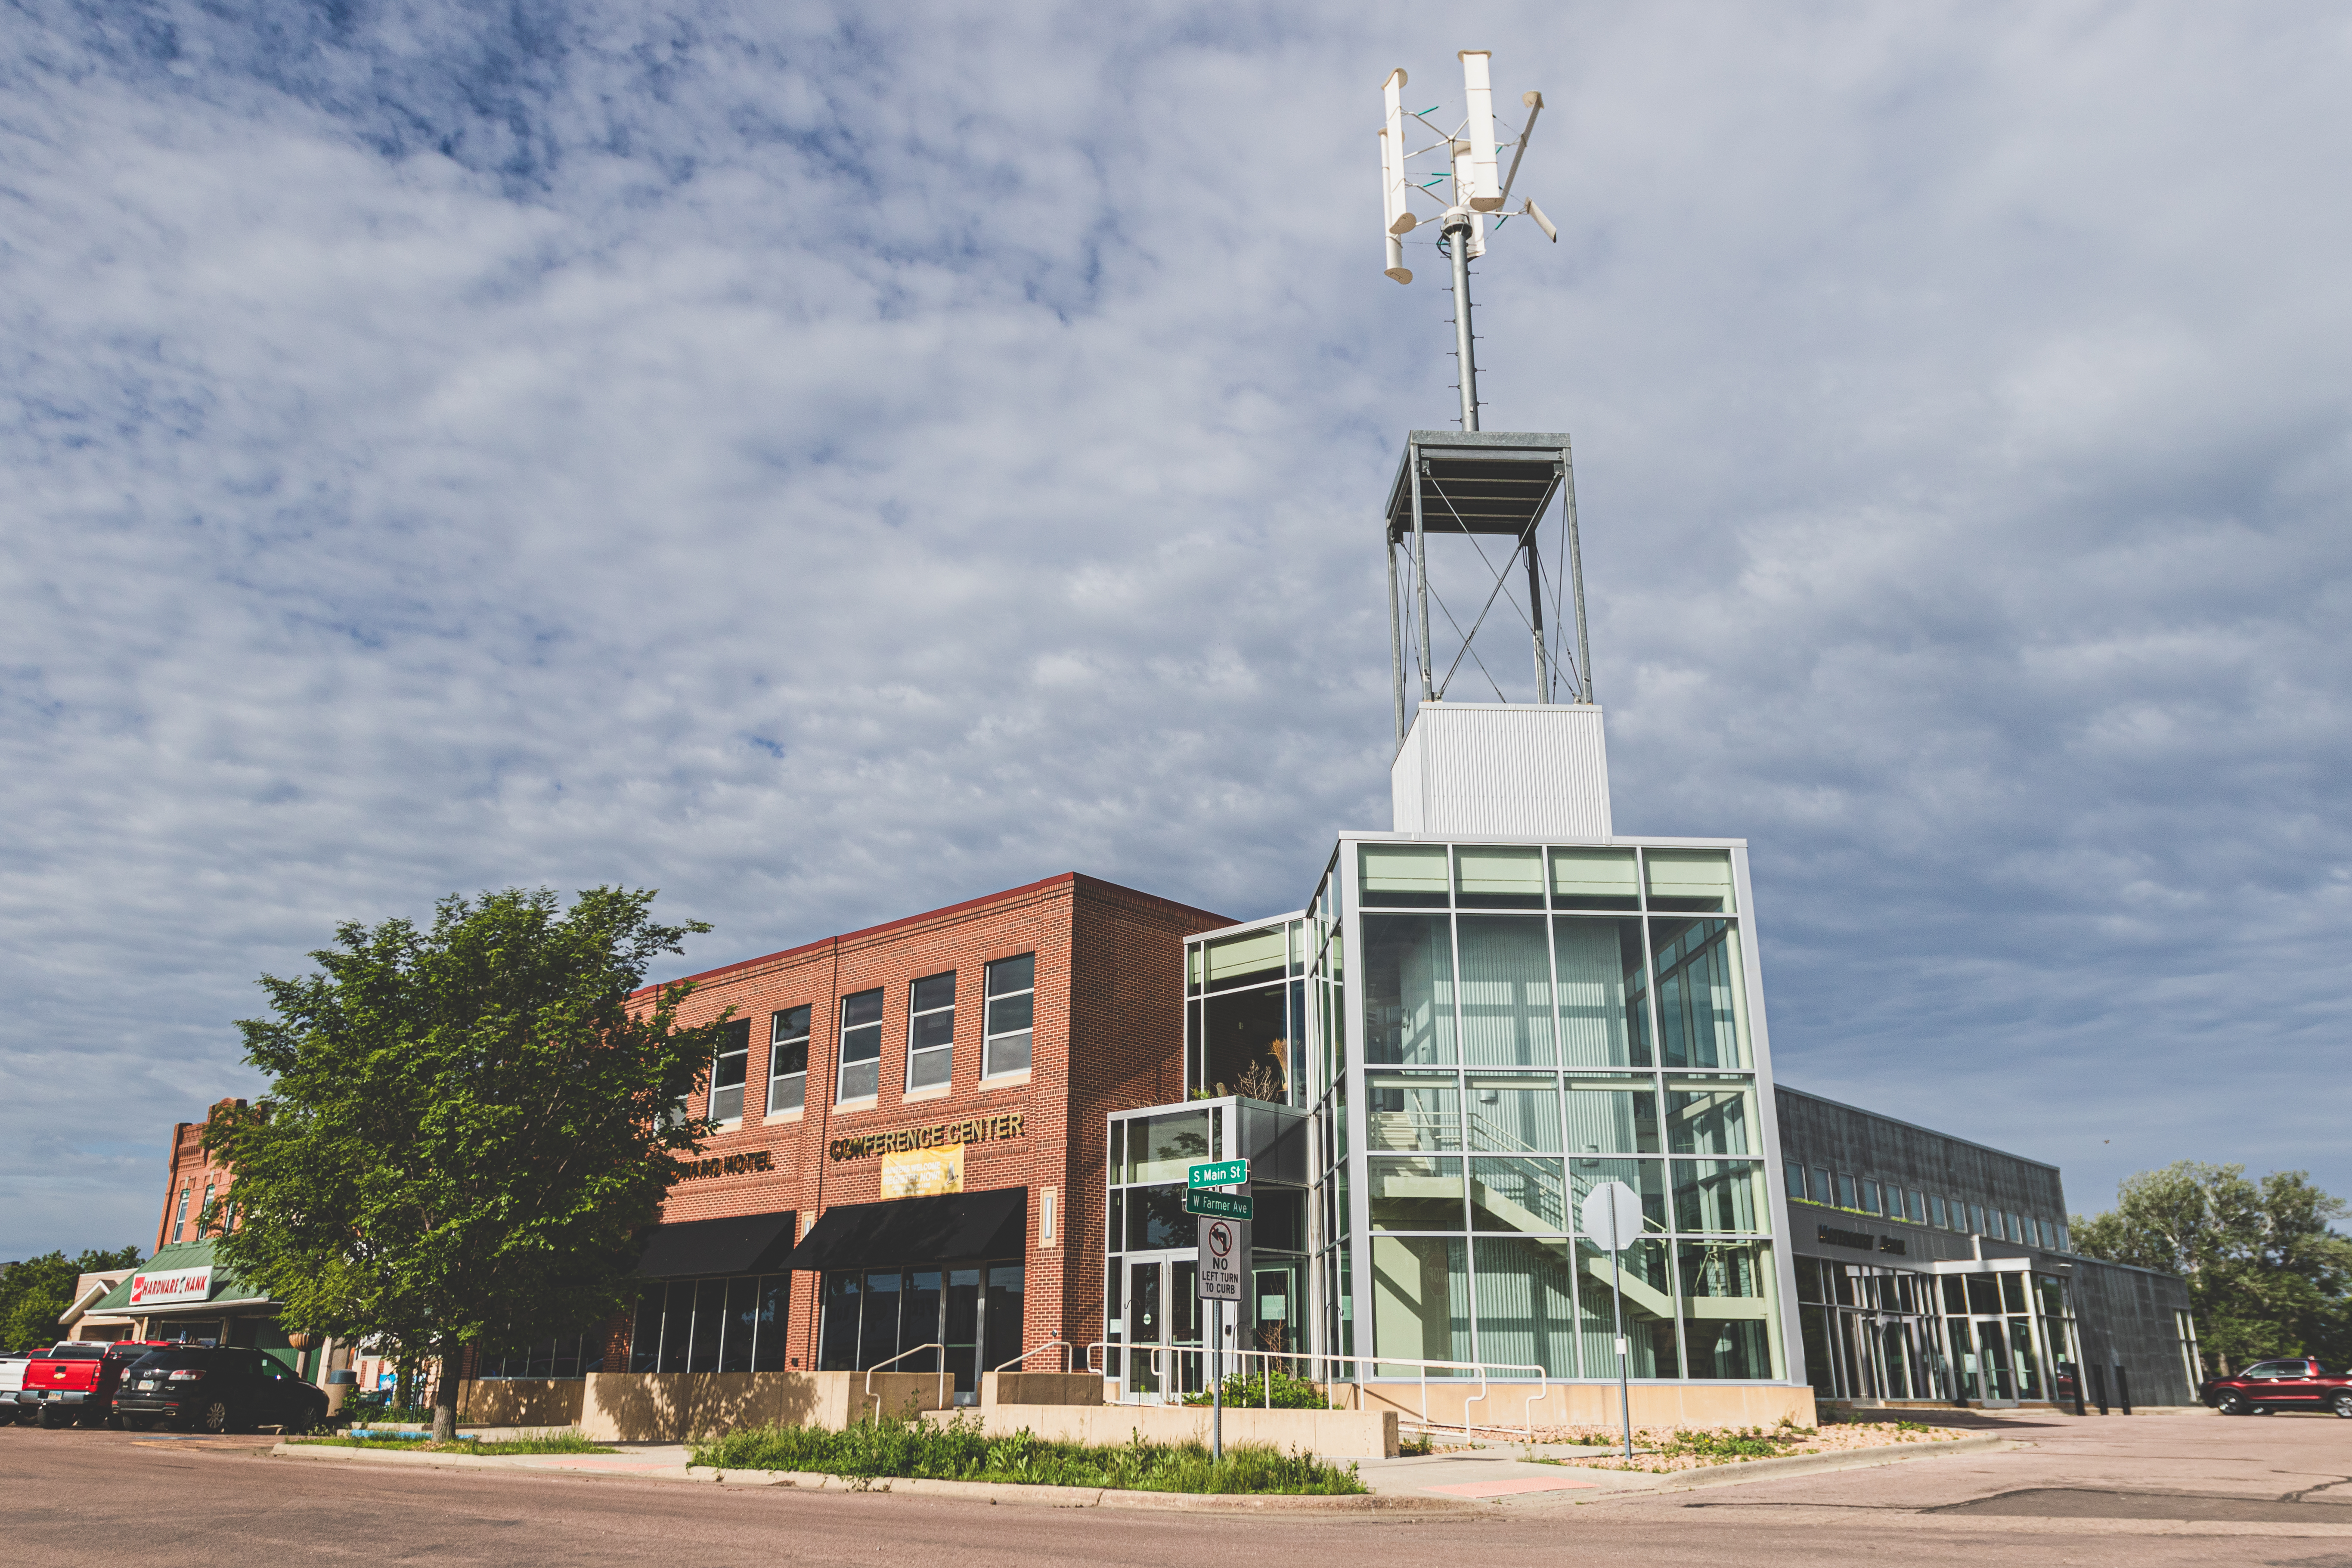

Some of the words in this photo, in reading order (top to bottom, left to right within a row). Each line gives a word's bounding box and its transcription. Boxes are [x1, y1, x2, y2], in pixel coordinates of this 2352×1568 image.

[830, 1125, 944, 1161] CONFERENCE
[947, 1113, 1024, 1143] CENTER
[724, 1150, 775, 1176] HOTEL
[883, 1164, 910, 1175] HUNTERS
[911, 1161, 941, 1172] WELCOME
[883, 1174, 918, 1185] REGISTER
[920, 1171, 940, 1182] NOW!
[1194, 1171, 1200, 1183] S
[1204, 1168, 1226, 1181] Main
[1230, 1166, 1240, 1178] St
[1193, 1195, 1200, 1207] W
[1203, 1196, 1230, 1211] Farmer
[1233, 1200, 1247, 1214] Ave
[1213, 1257, 1228, 1271] NO
[1202, 1271, 1218, 1282] LEFT
[1220, 1272, 1238, 1283] TURN
[142, 1278, 179, 1295] HARDWARE
[184, 1275, 208, 1292] HANK
[1205, 1282, 1214, 1293] TO
[1216, 1283, 1235, 1294] CURB
